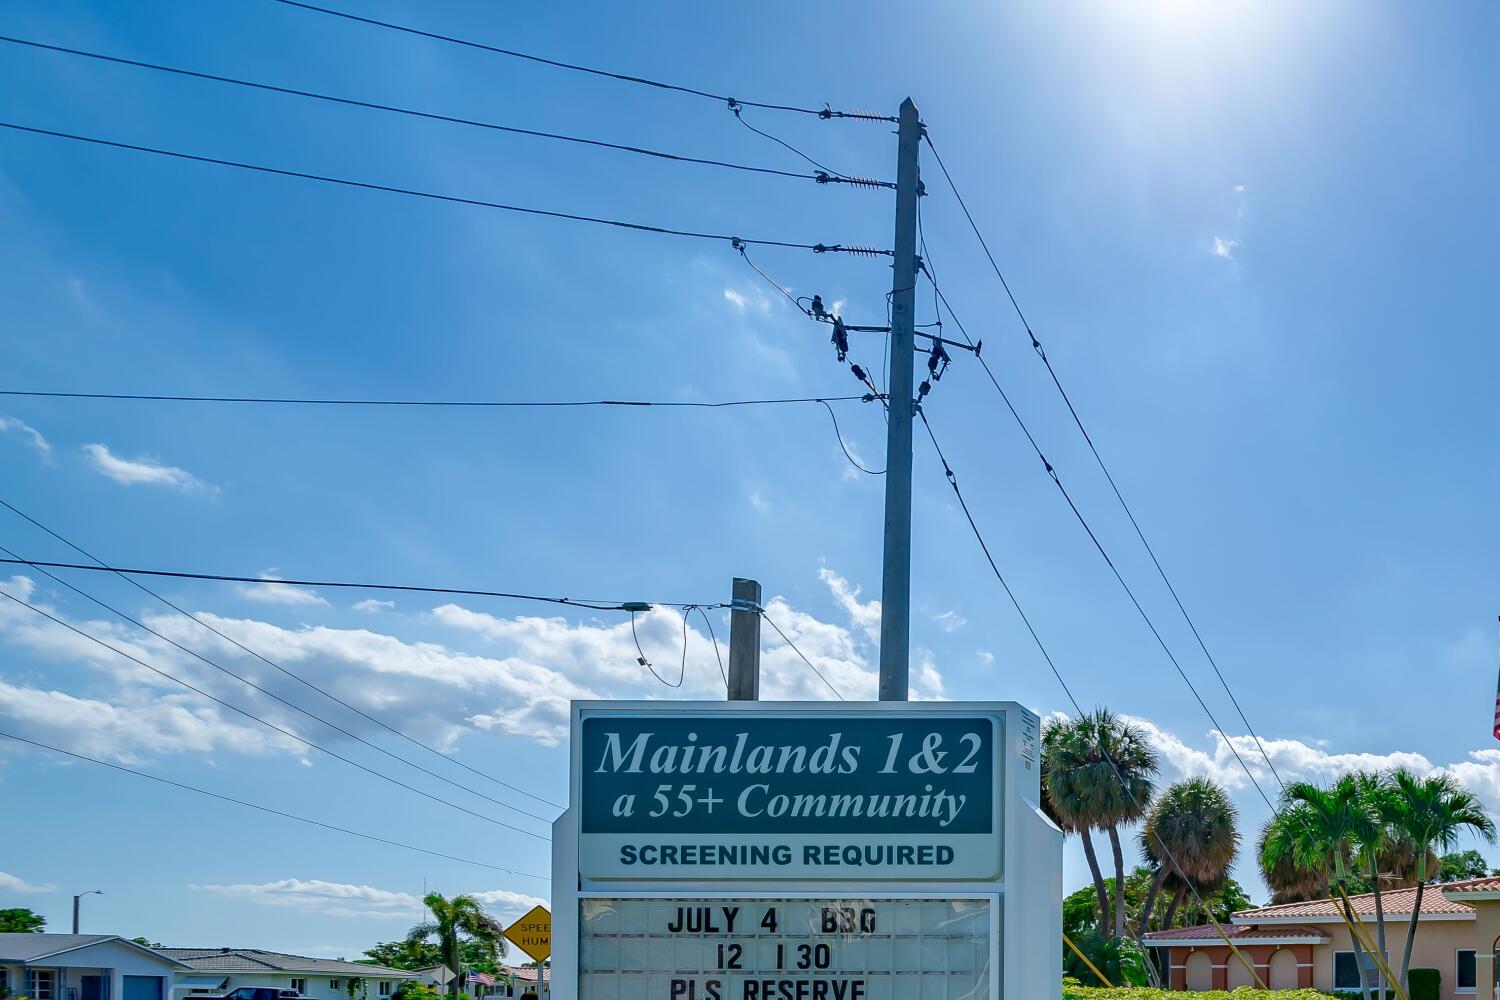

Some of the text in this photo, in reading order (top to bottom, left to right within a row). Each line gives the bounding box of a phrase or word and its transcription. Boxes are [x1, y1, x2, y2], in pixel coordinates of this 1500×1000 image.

[594, 732, 861, 774] Mainlands
[877, 732, 982, 774] 1&2
[612, 783, 966, 827] a 55+ Community
[619, 844, 955, 867] SCREENING REQUIRED
[520, 923, 551, 933] SPEE
[667, 906, 740, 933] JULY
[760, 907, 778, 933] 4
[522, 937, 549, 946] HUM
[717, 943, 743, 969] 12
